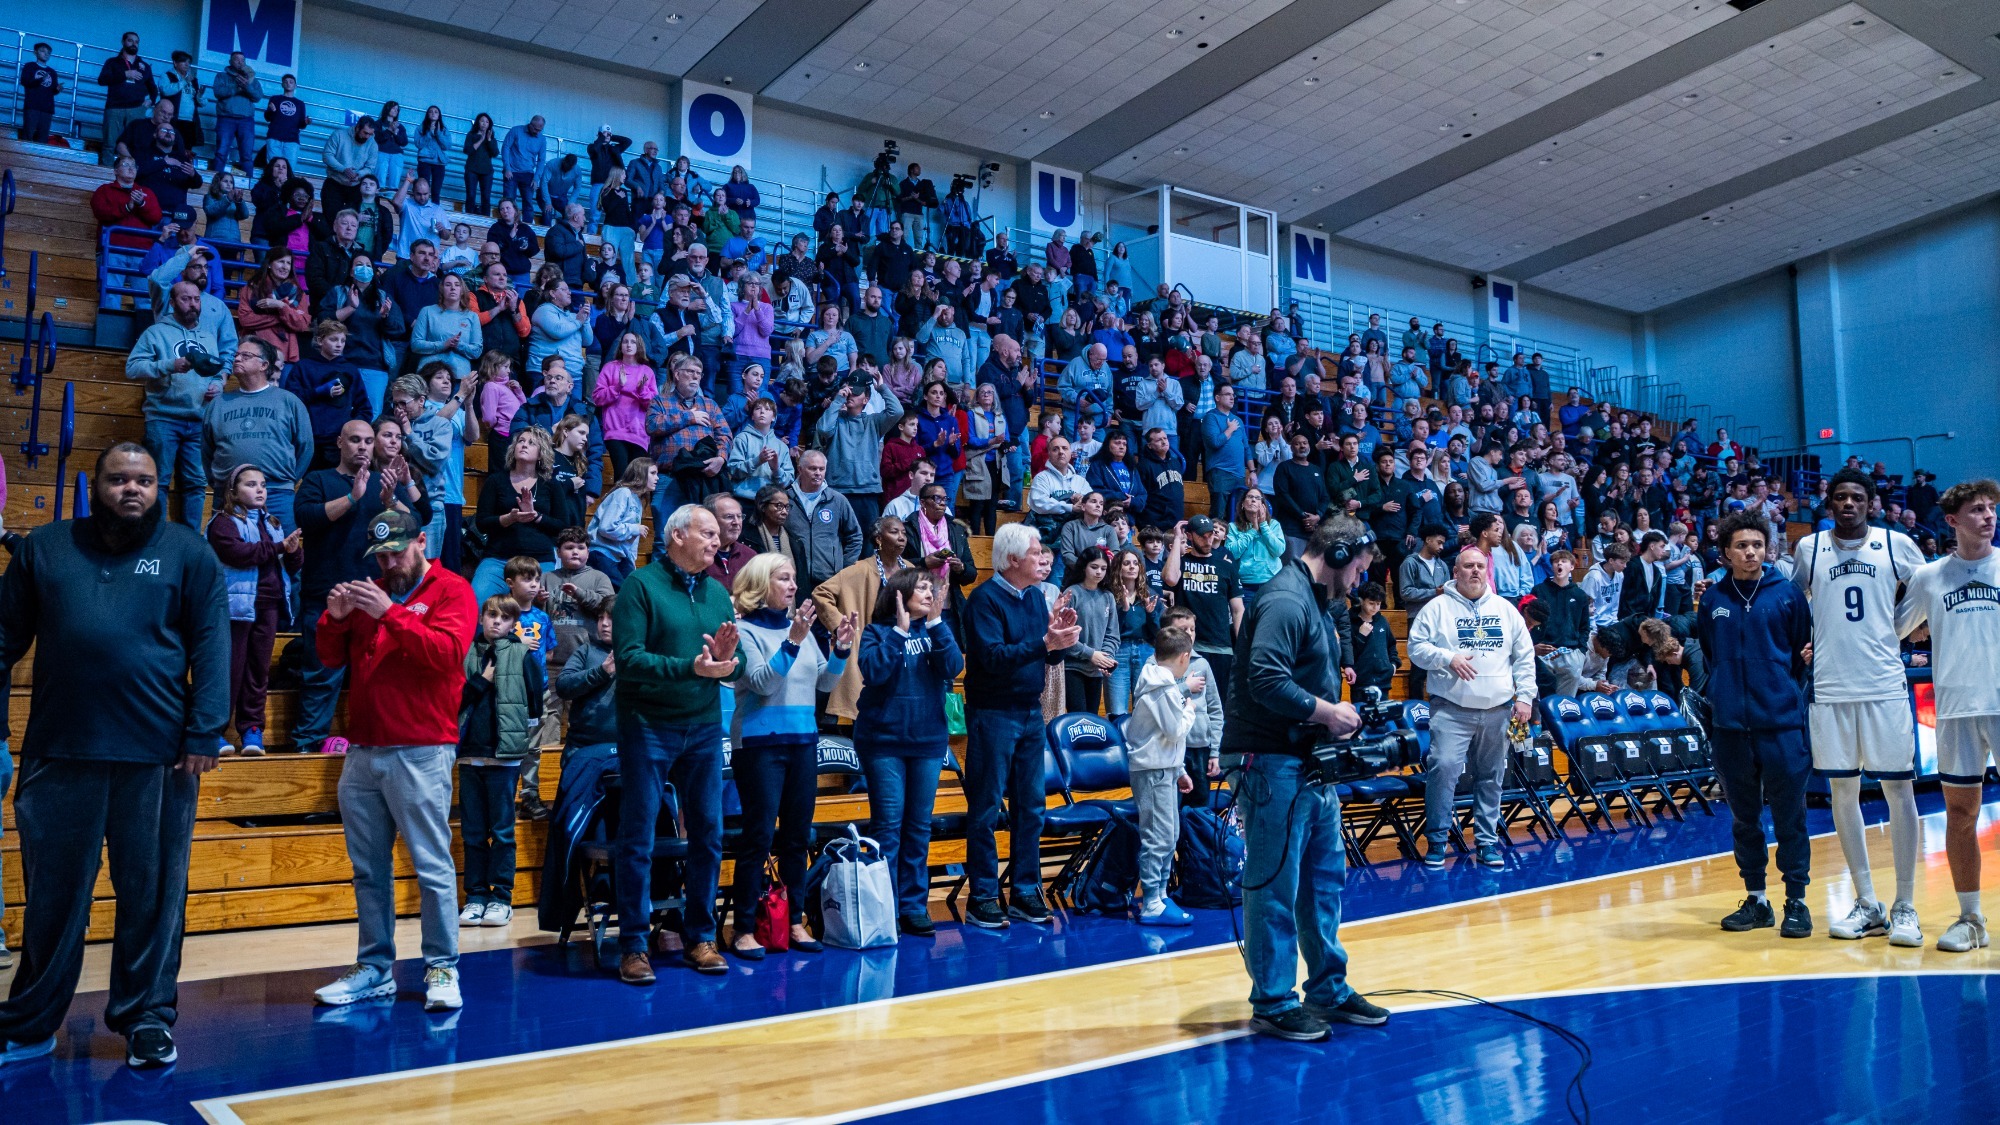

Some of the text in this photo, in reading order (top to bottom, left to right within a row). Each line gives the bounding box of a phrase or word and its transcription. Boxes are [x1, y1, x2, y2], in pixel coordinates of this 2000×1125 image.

[207, 0, 296, 68] M
[689, 93, 746, 157] O
[1039, 171, 1076, 228] U
[1295, 233, 1327, 283] N
[1493, 282, 1514, 324] T
[223, 406, 276, 422] VILLANOVA
[34, 495, 46, 509] G
[134, 559, 160, 575] M
[1184, 561, 1217, 575] KNOTT
[1829, 563, 1876, 579] THE MOUNT
[1182, 578, 1219, 594] HOUSE
[1844, 585, 1865, 622] 9
[1944, 589, 1966, 610] THE
[1955, 605, 1996, 614] BASKETBALL
[1458, 640, 1504, 650] CHAMPIONS
[1069, 725, 1107, 739] THE MOUNT
[822, 748, 857, 765] MOUNT
